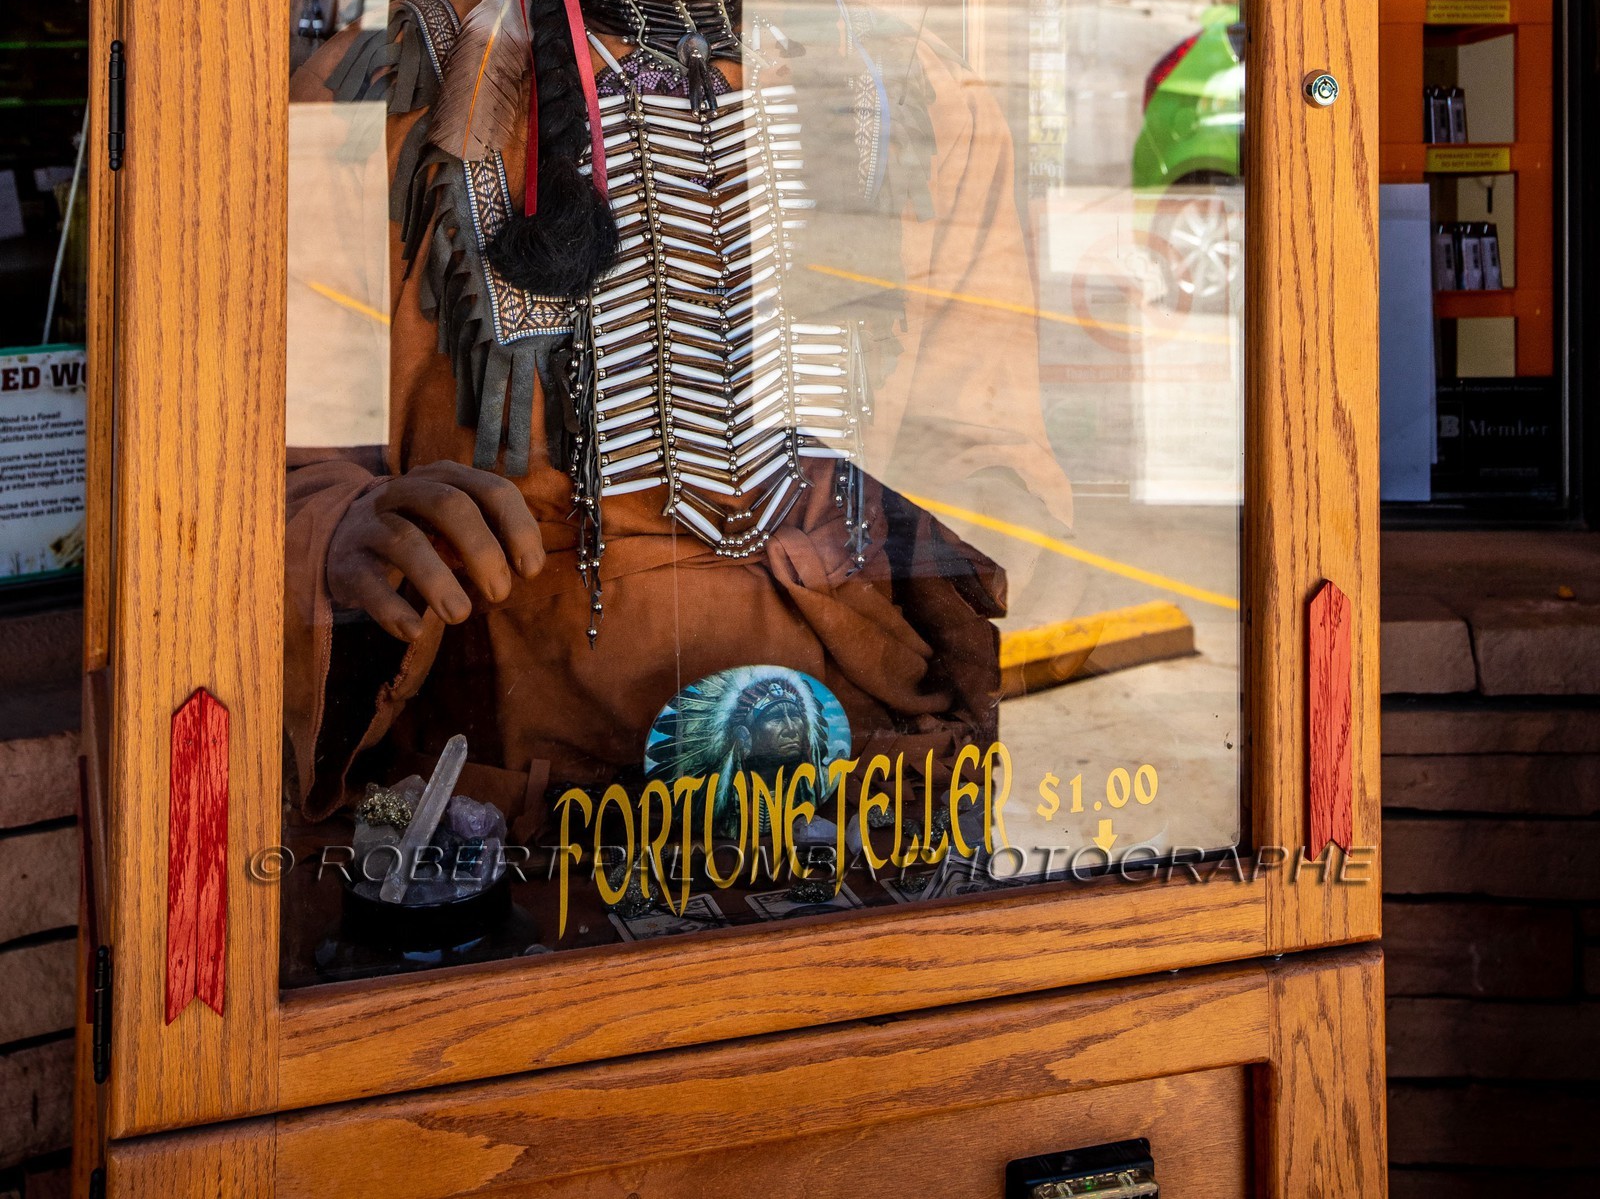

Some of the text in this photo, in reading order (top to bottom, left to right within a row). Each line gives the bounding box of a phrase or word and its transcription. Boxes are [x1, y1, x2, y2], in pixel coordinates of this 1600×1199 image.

[1468, 419, 1549, 437] Member
[1037, 764, 1159, 821] $1.00
[554, 741, 1015, 939] FORTUNE TELLER
